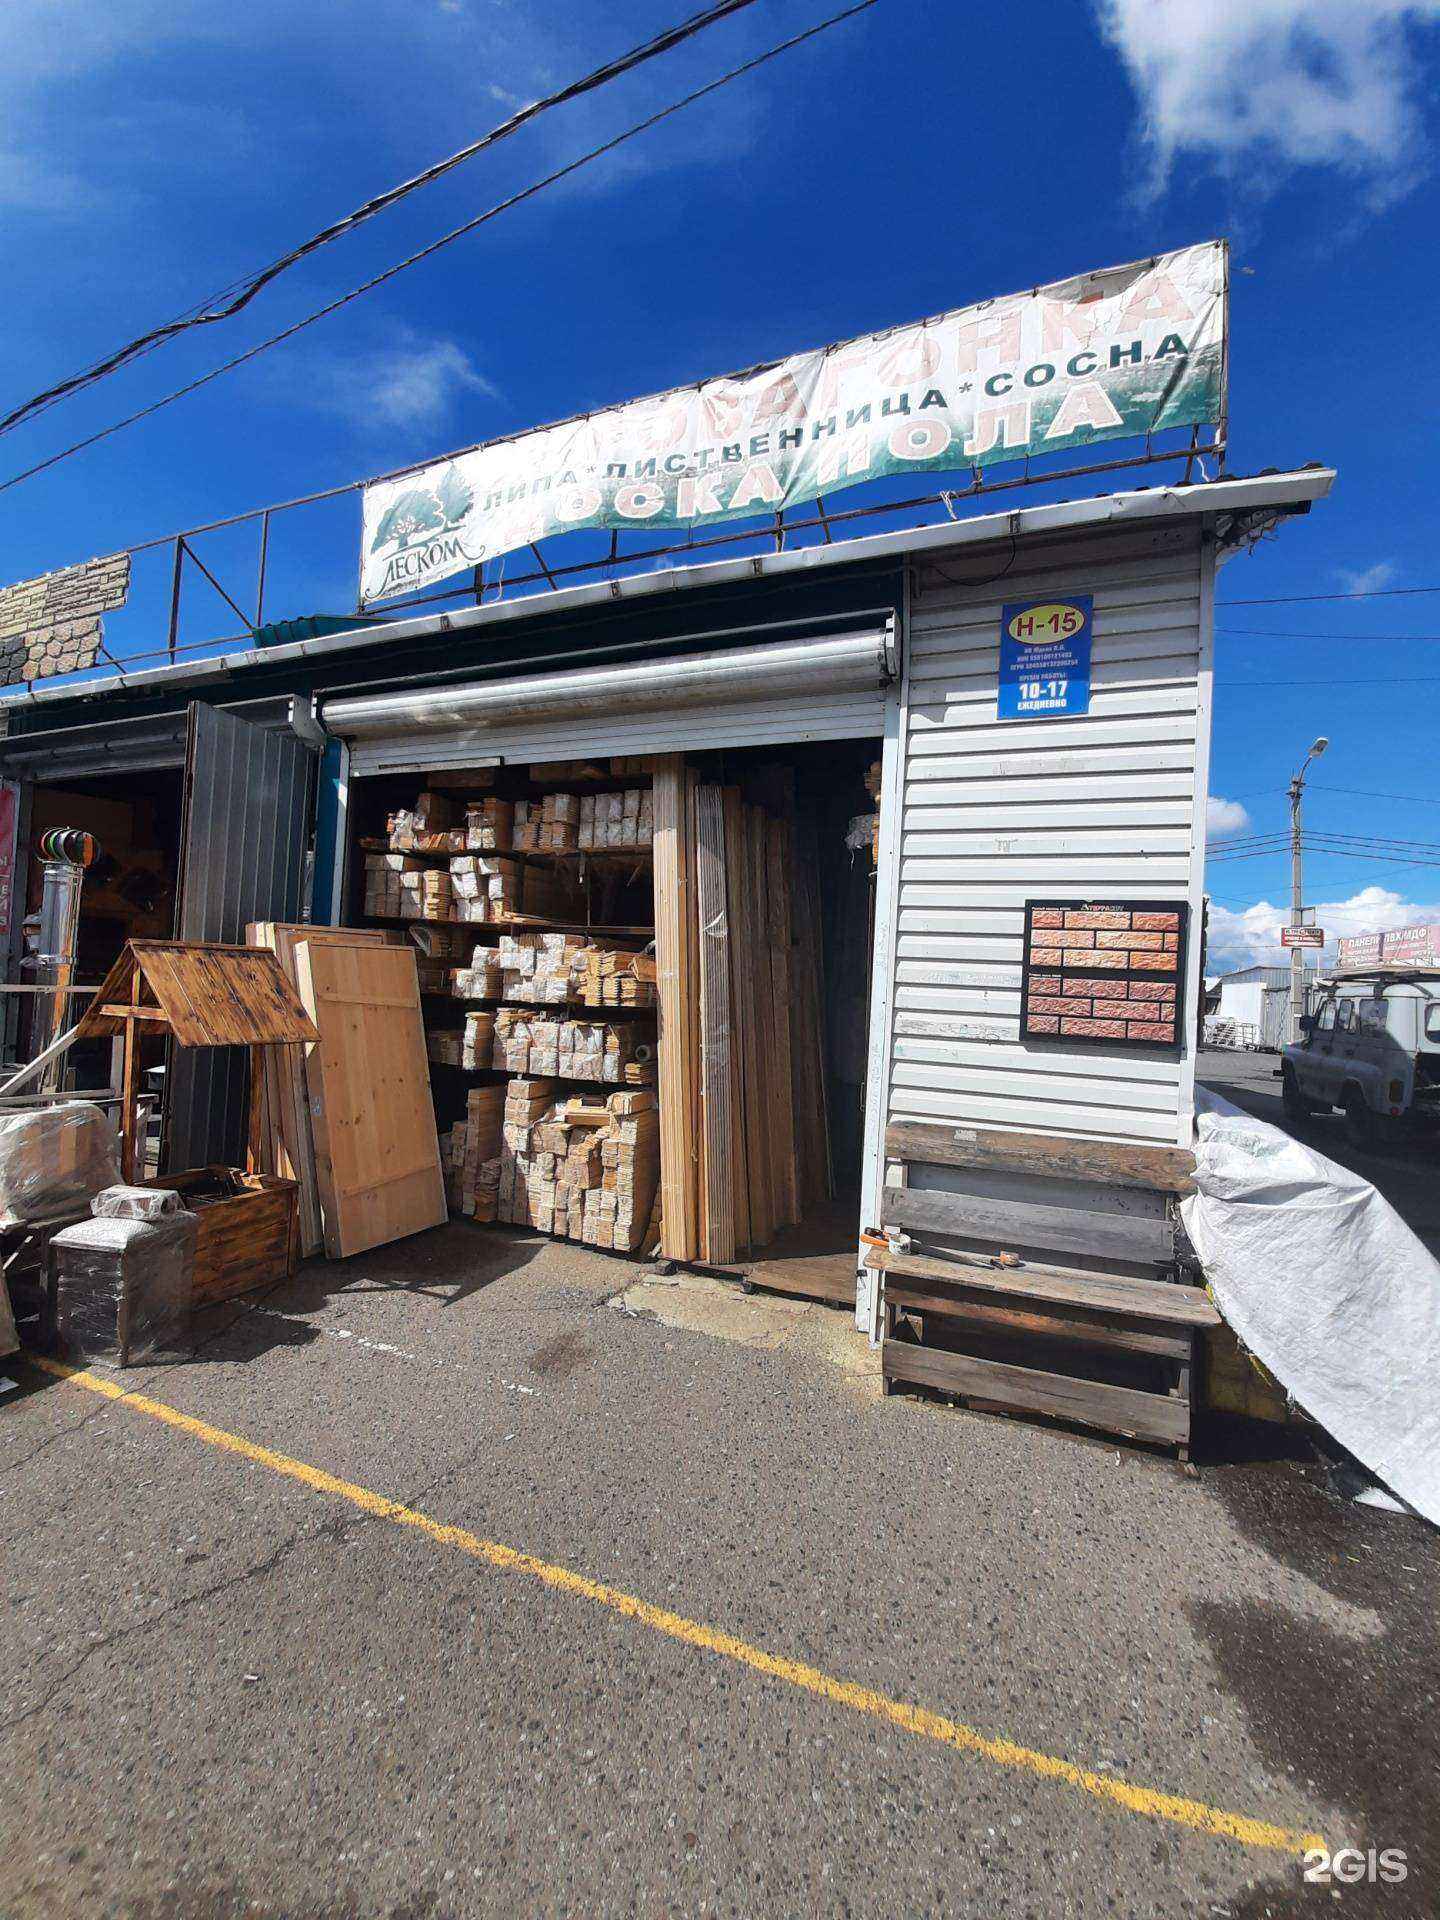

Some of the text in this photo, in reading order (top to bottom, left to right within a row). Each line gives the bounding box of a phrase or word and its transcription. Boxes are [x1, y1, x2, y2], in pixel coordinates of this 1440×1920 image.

[482, 333, 1190, 512] ЛИПА ЛИСТВЕННИЦА СОСНА
[817, 381, 1125, 487] ПОЛА
[365, 537, 486, 599] ЛЕСКОМ
[1016, 611, 1077, 636] Н-15
[1017, 698, 1068, 711] ЕЖЕДНЕВНО
[1019, 681, 1068, 699] 10-17
